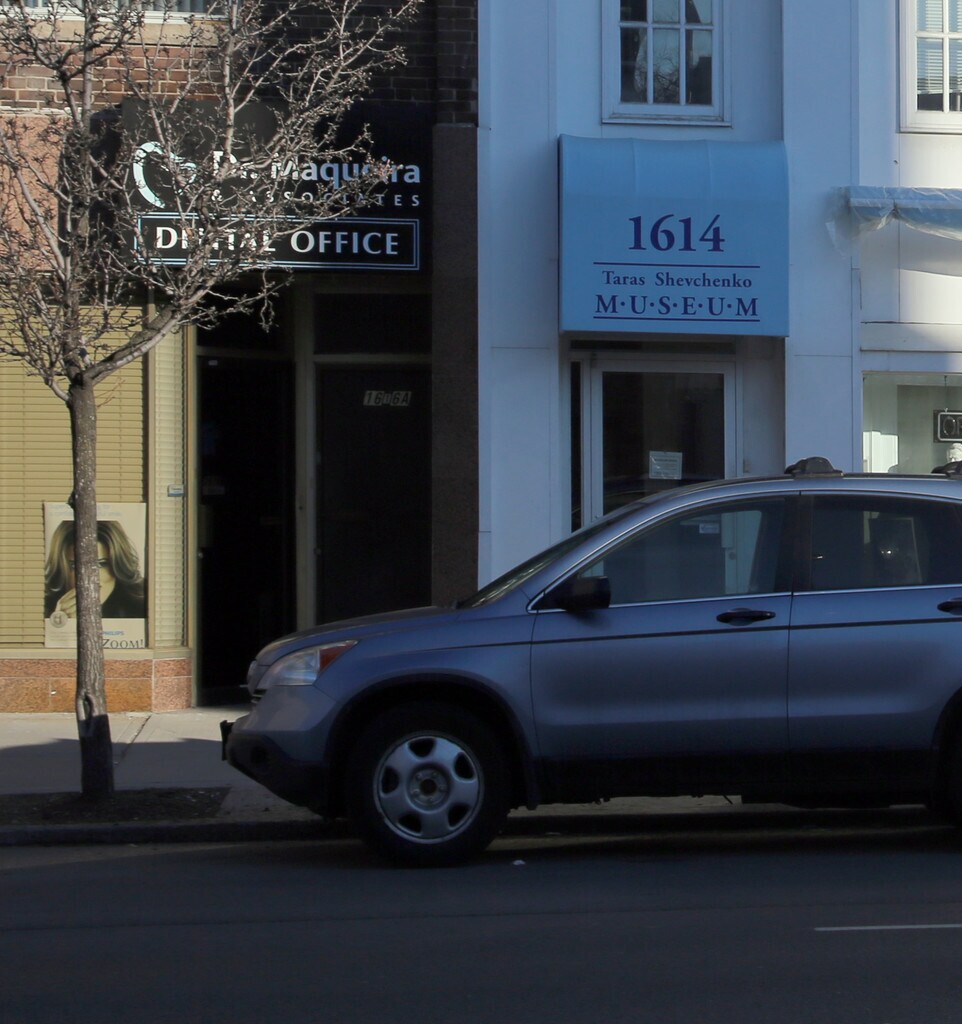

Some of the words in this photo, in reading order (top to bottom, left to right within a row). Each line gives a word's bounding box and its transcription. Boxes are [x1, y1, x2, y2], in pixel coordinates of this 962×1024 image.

[290, 230, 398, 254] OFFICE
[628, 213, 725, 252] 1614
[602, 270, 646, 286] Taras
[655, 271, 752, 289] Shevchenko
